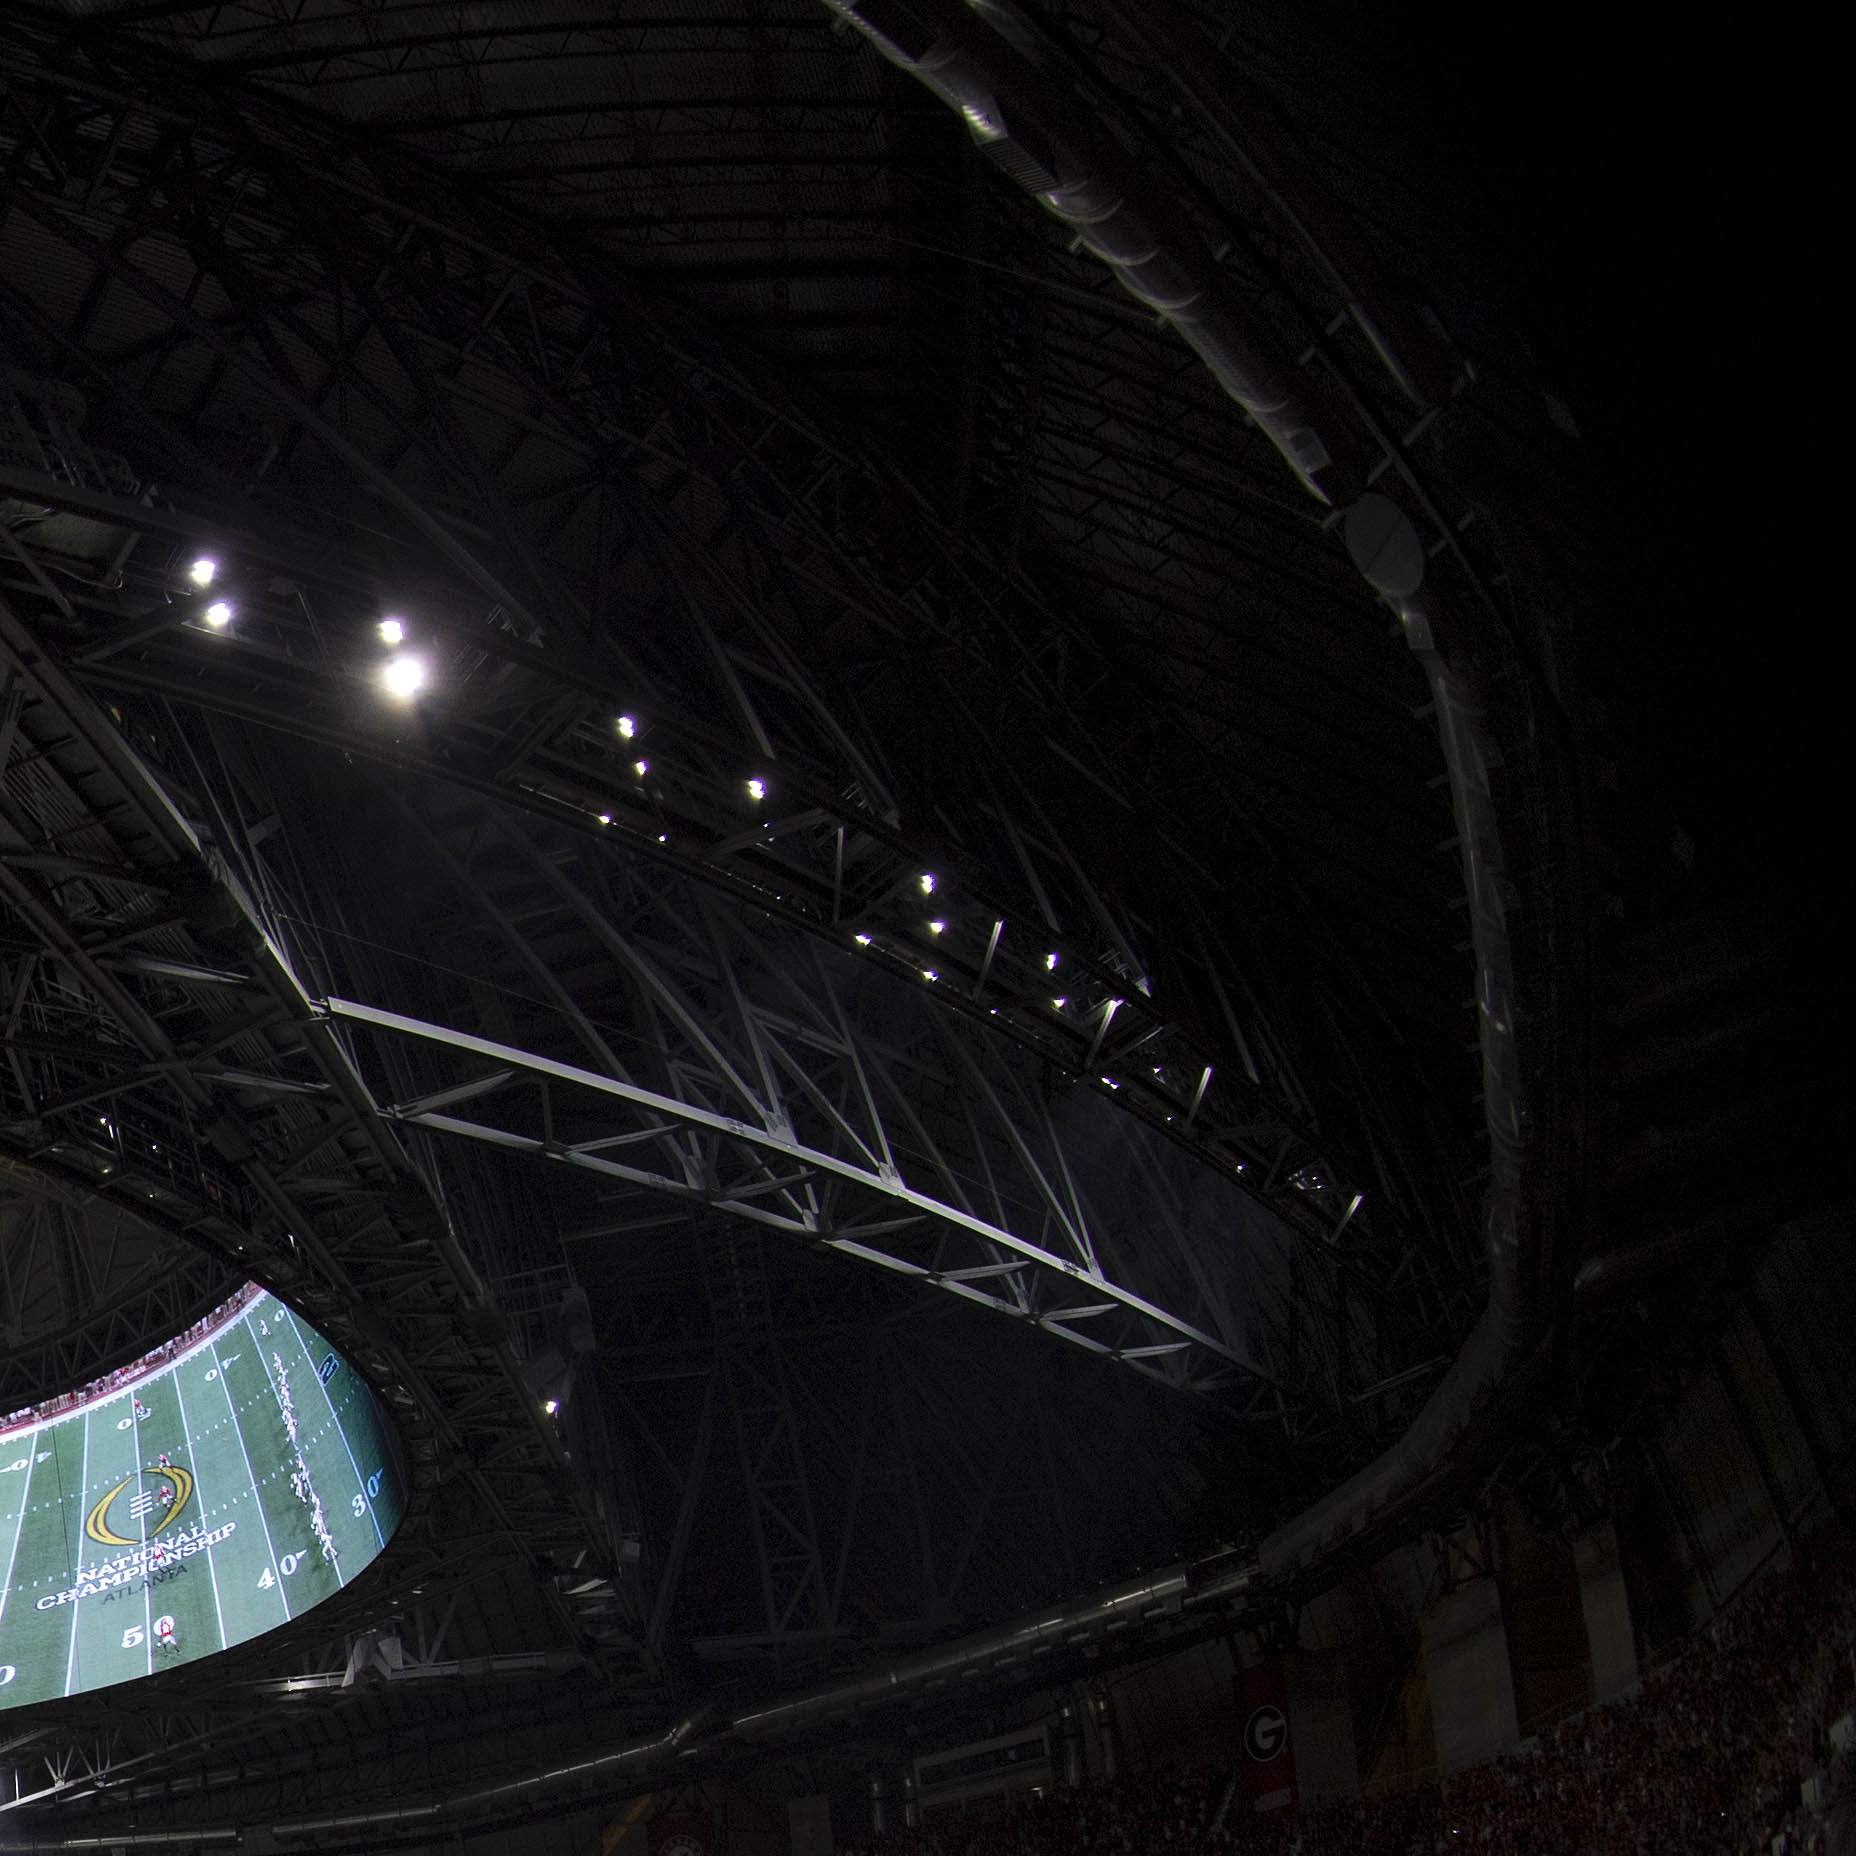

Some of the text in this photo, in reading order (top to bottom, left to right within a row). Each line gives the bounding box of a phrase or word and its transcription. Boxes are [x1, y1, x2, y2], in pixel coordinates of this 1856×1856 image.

[36, 1522, 236, 1610] CHAMPIONSHIP
[74, 1525, 206, 1586] NATIONAL
[257, 1553, 298, 1590] 40
[102, 1564, 188, 1605] ATLANTA
